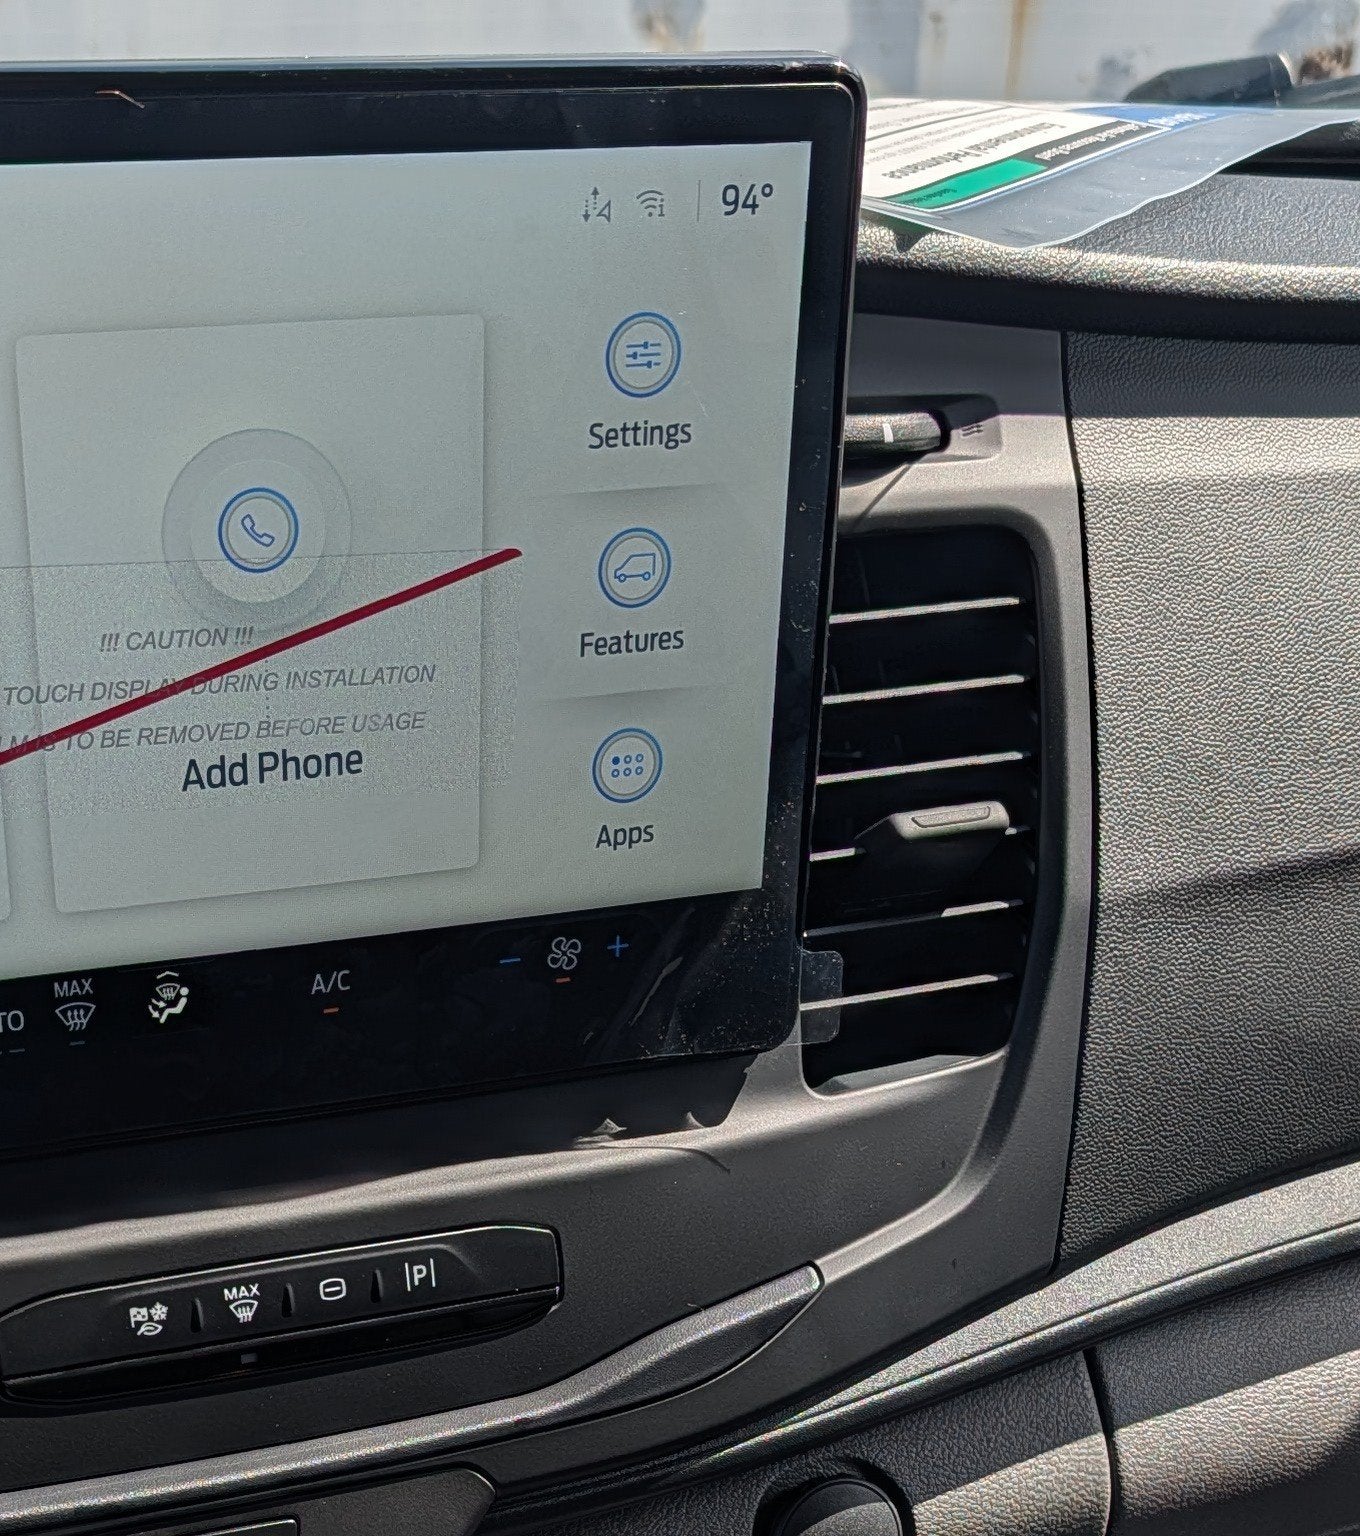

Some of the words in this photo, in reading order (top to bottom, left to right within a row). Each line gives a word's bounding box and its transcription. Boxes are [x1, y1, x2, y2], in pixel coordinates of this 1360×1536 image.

[721, 182, 774, 216] 94°
[588, 419, 692, 450] Settings
[126, 627, 228, 650] CAUTION
[579, 629, 685, 658] Features
[3, 682, 85, 706] TOUCH
[190, 671, 279, 695] DURING
[285, 664, 436, 689] INSTALLATION
[64, 731, 95, 751] TO
[100, 728, 132, 748] BE
[136, 721, 250, 747] REMOVED
[256, 716, 346, 740] BEFORE
[351, 712, 426, 734] USAGE
[181, 754, 250, 793] Add
[257, 748, 365, 785] Phone
[595, 824, 654, 851] Apps
[52, 978, 95, 999] MAX
[310, 969, 352, 995] A/C
[223, 1282, 261, 1302] MAX
